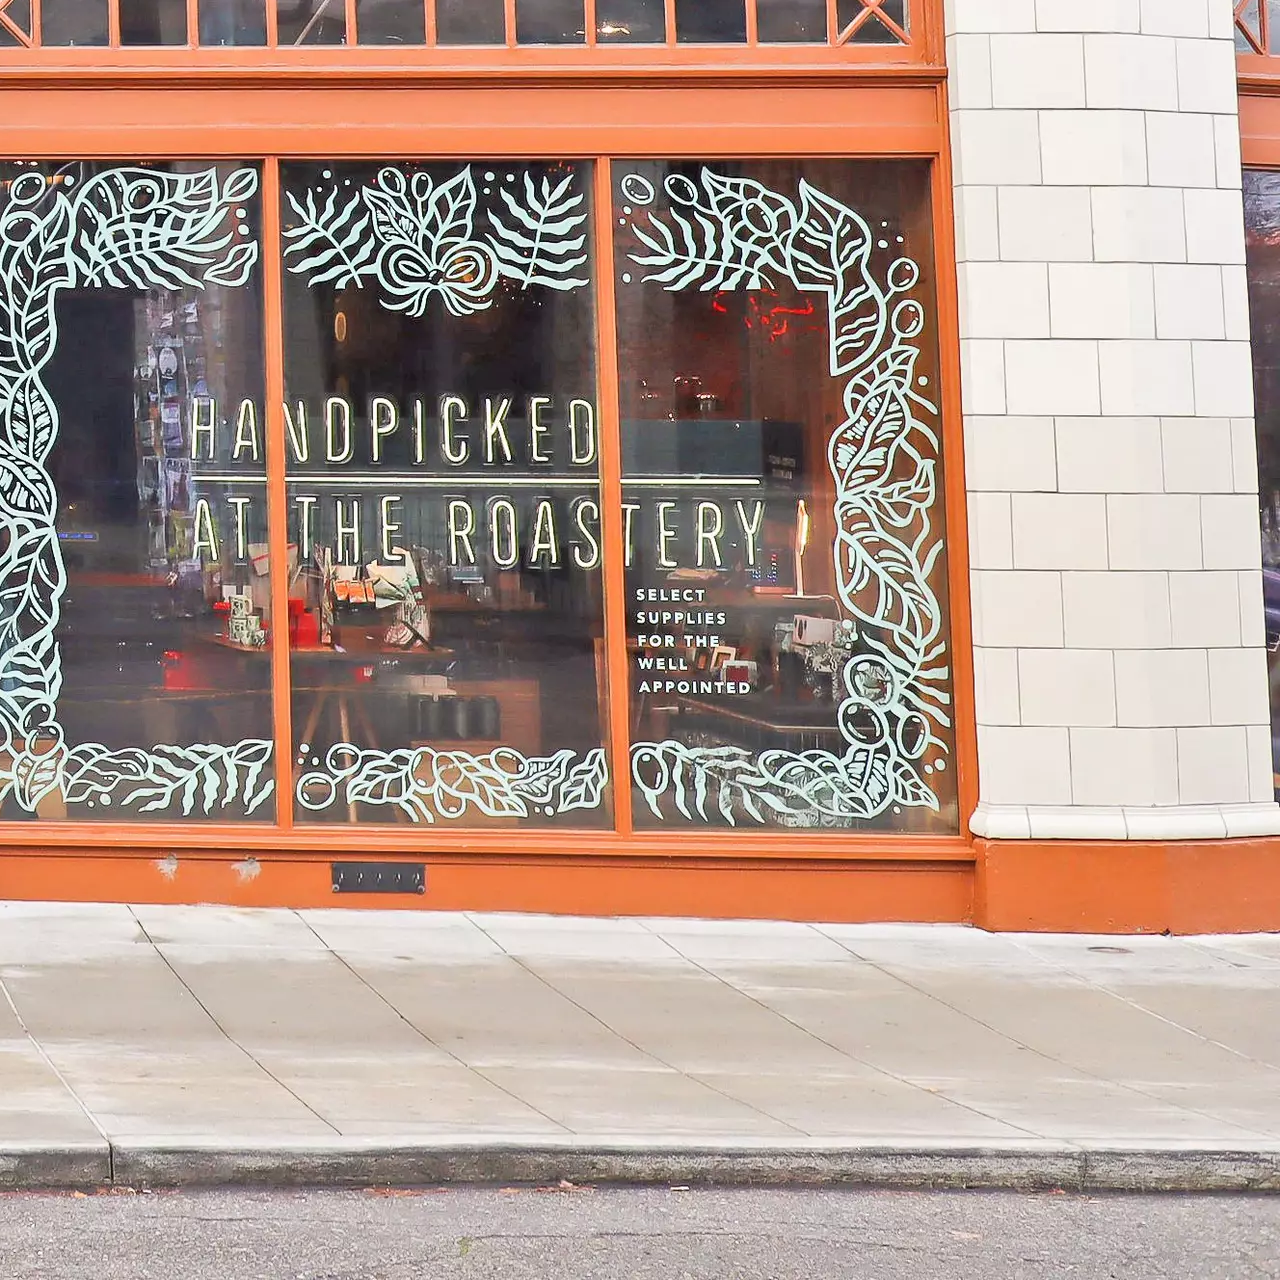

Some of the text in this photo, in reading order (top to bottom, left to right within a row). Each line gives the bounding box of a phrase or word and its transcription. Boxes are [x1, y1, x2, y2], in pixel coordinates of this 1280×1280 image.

[191, 396, 595, 465] HANDPICKED
[192, 496, 763, 569] AT THE ROASTERY
[636, 588, 706, 602] SELECT
[636, 611, 727, 625] SUPPLIES
[638, 635, 719, 648] FOR THE
[638, 658, 688, 671] WELL
[639, 681, 751, 694] APPOINTED
